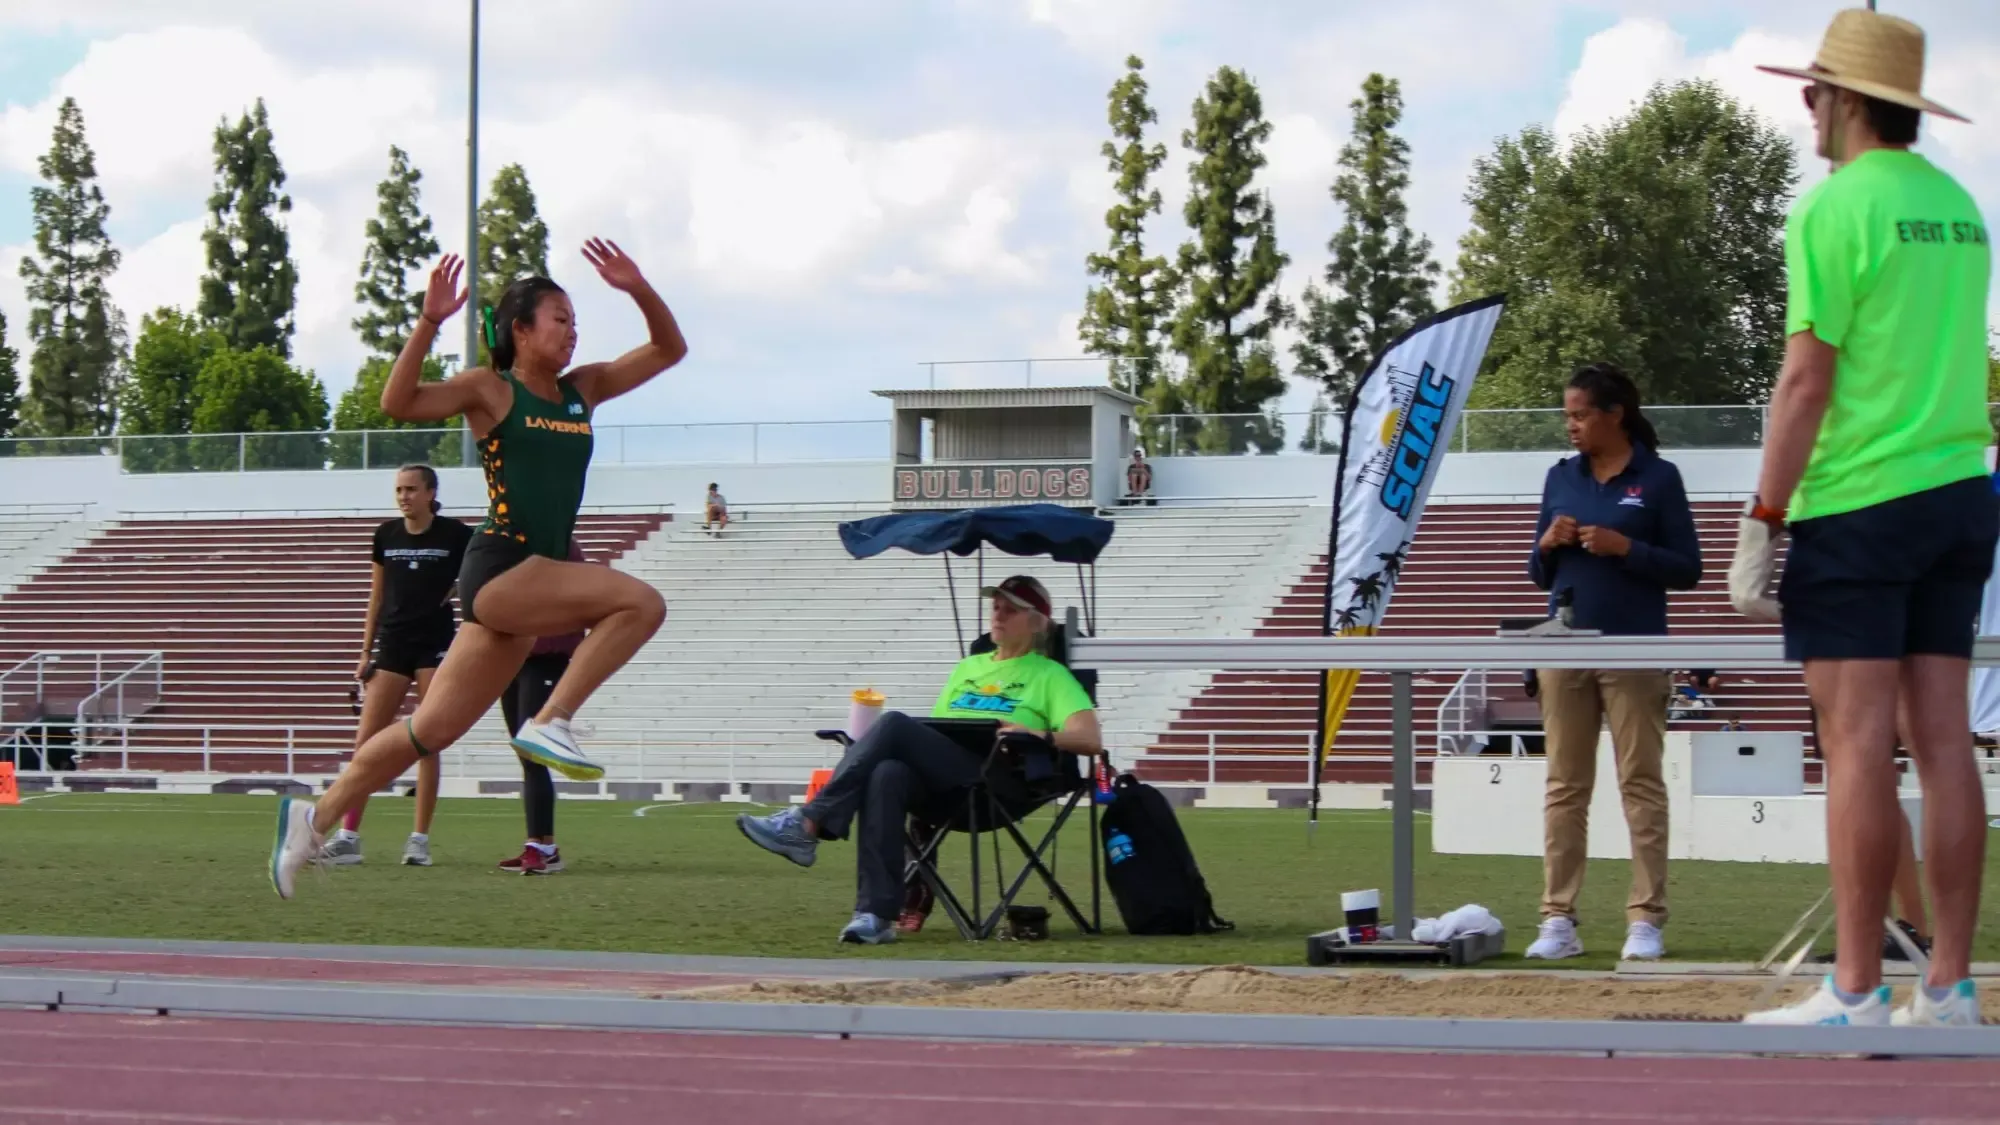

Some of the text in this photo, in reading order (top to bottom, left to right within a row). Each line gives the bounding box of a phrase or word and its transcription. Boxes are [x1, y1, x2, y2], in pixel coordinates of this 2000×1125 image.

[1896, 219, 1945, 243] EVENT
[1380, 361, 1454, 522] SCIAC
[897, 468, 1090, 499] BULLDOGS
[1490, 763, 1502, 784] 2
[1752, 801, 1765, 823] 3
